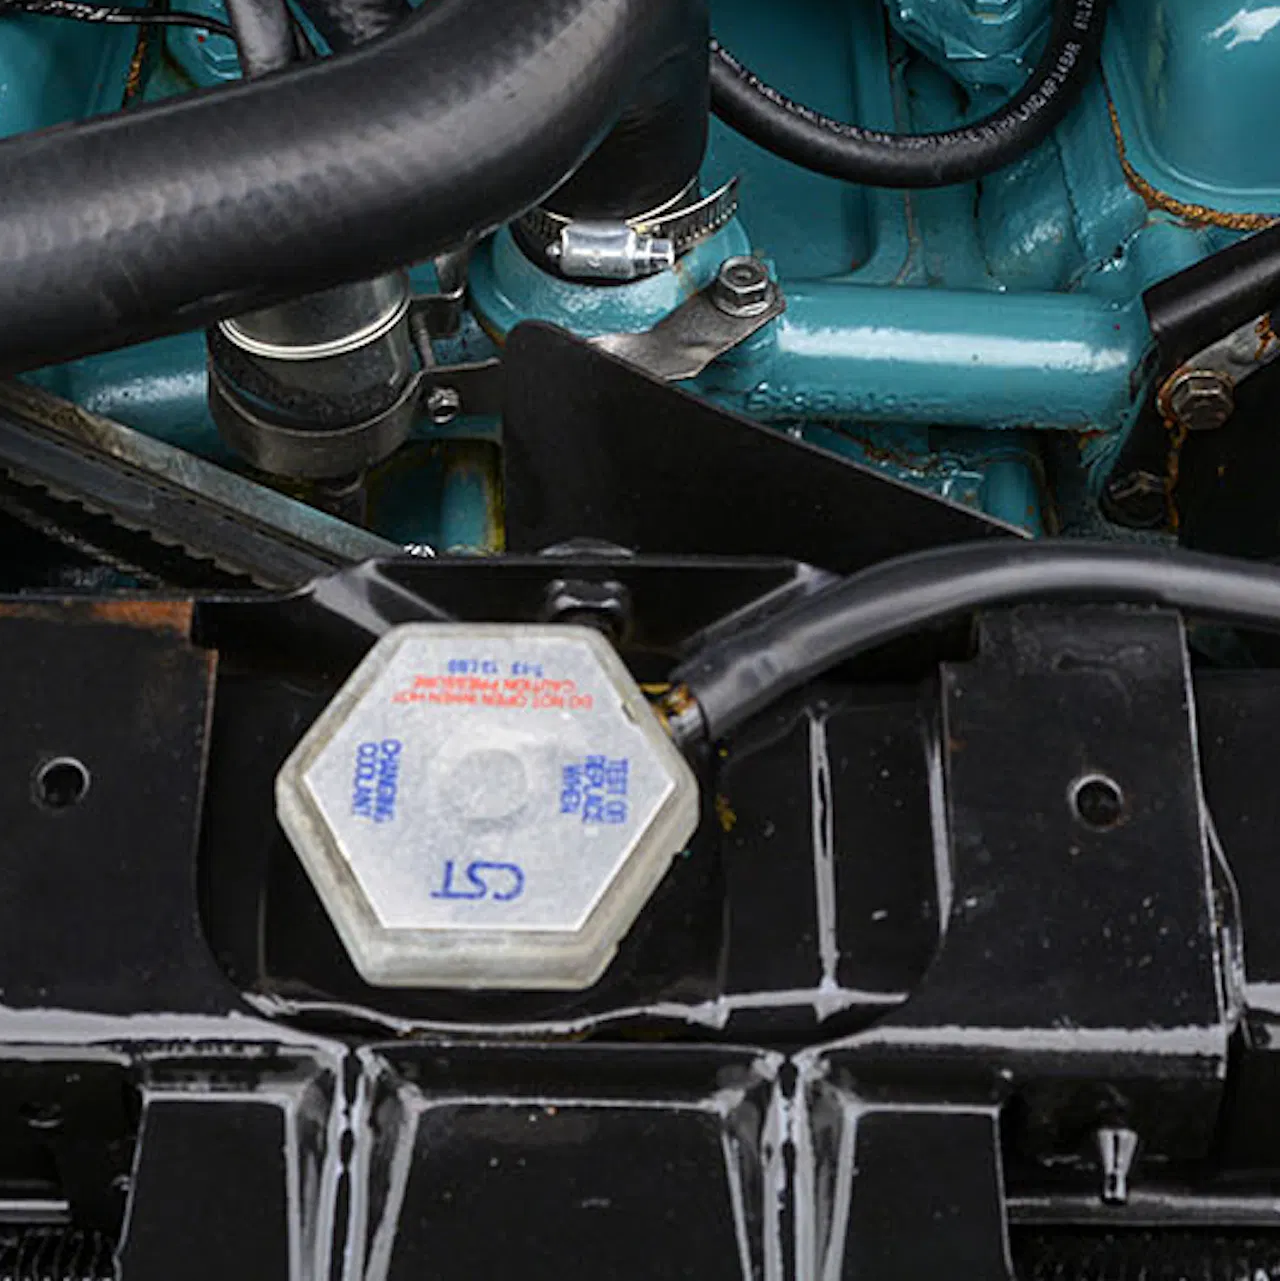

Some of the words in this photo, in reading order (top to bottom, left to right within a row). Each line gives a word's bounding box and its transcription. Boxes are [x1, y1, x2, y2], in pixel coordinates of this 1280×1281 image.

[482, 693, 528, 708] OPEN
[532, 694, 563, 709] NOT
[569, 694, 593, 710] DO
[352, 742, 380, 818] COOLANT
[374, 738, 403, 824] CHANGING
[561, 764, 583, 814] WHEN
[582, 755, 606, 824] REPLACE
[606, 759, 629, 795] TEST
[430, 860, 525, 901] CST
